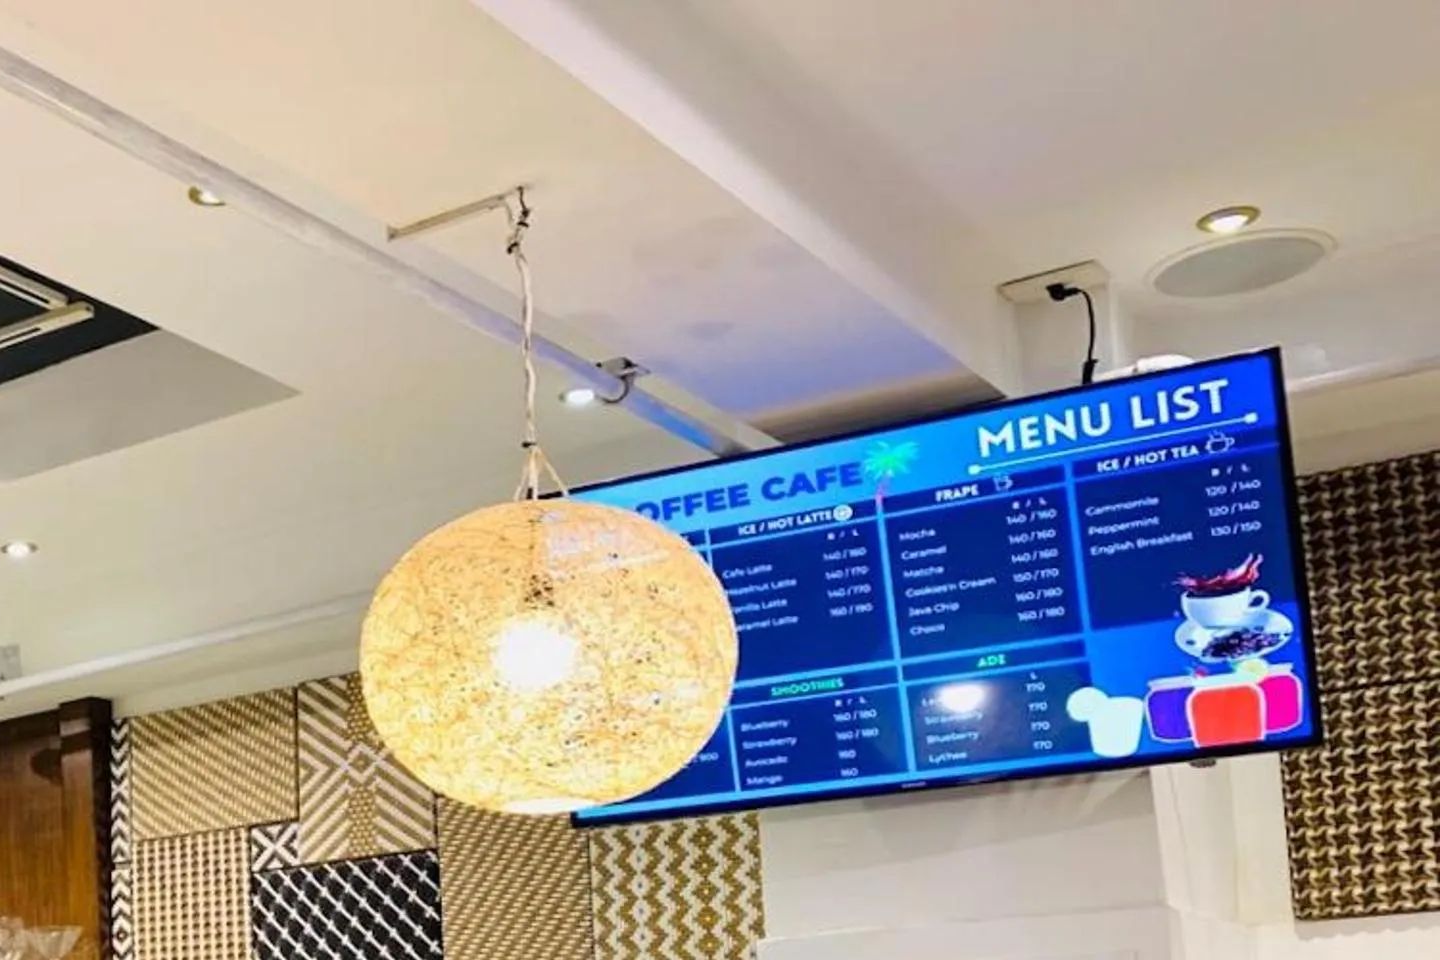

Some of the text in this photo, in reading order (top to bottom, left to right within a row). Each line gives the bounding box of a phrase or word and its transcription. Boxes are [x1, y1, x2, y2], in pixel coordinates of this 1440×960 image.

[977, 378, 1229, 458] MENU LIST
[1096, 459, 1119, 473] ICE
[1134, 451, 1167, 466] HOT
[1169, 445, 1200, 459] TEA
[636, 461, 863, 521] OFFEE CAFE
[935, 484, 979, 502] FRAPE
[738, 523, 756, 536] ICE
[768, 517, 793, 531] HOT
[796, 511, 832, 526] LATTE
[1087, 516, 1160, 536] Peppermint
[1090, 531, 1193, 556] English Breakfast
[737, 618, 770, 632] aramel
